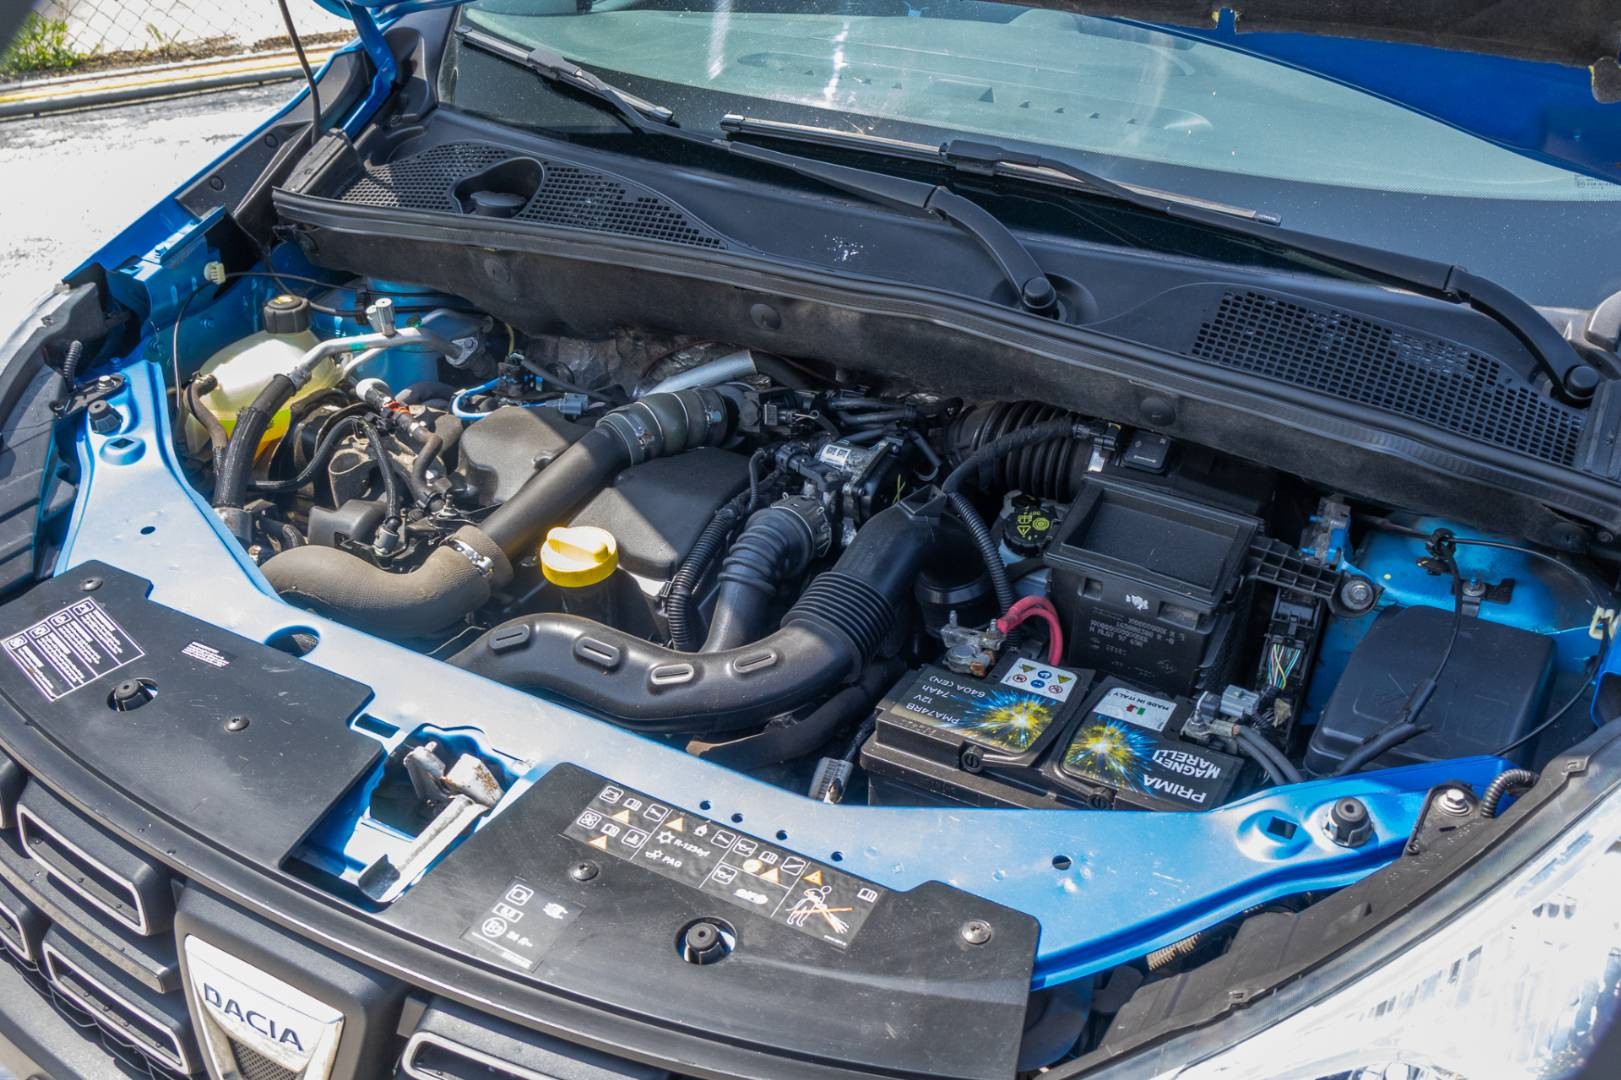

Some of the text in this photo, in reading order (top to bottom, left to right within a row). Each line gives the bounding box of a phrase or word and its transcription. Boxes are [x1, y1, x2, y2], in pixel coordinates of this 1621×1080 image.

[913, 693, 933, 704] 12V
[922, 685, 951, 698] 74Ah
[1112, 691, 1170, 711] MADE IN ITALY
[905, 702, 960, 725] PMA74RB
[1143, 774, 1207, 804] PRIMA
[203, 982, 304, 1051] DACIA
